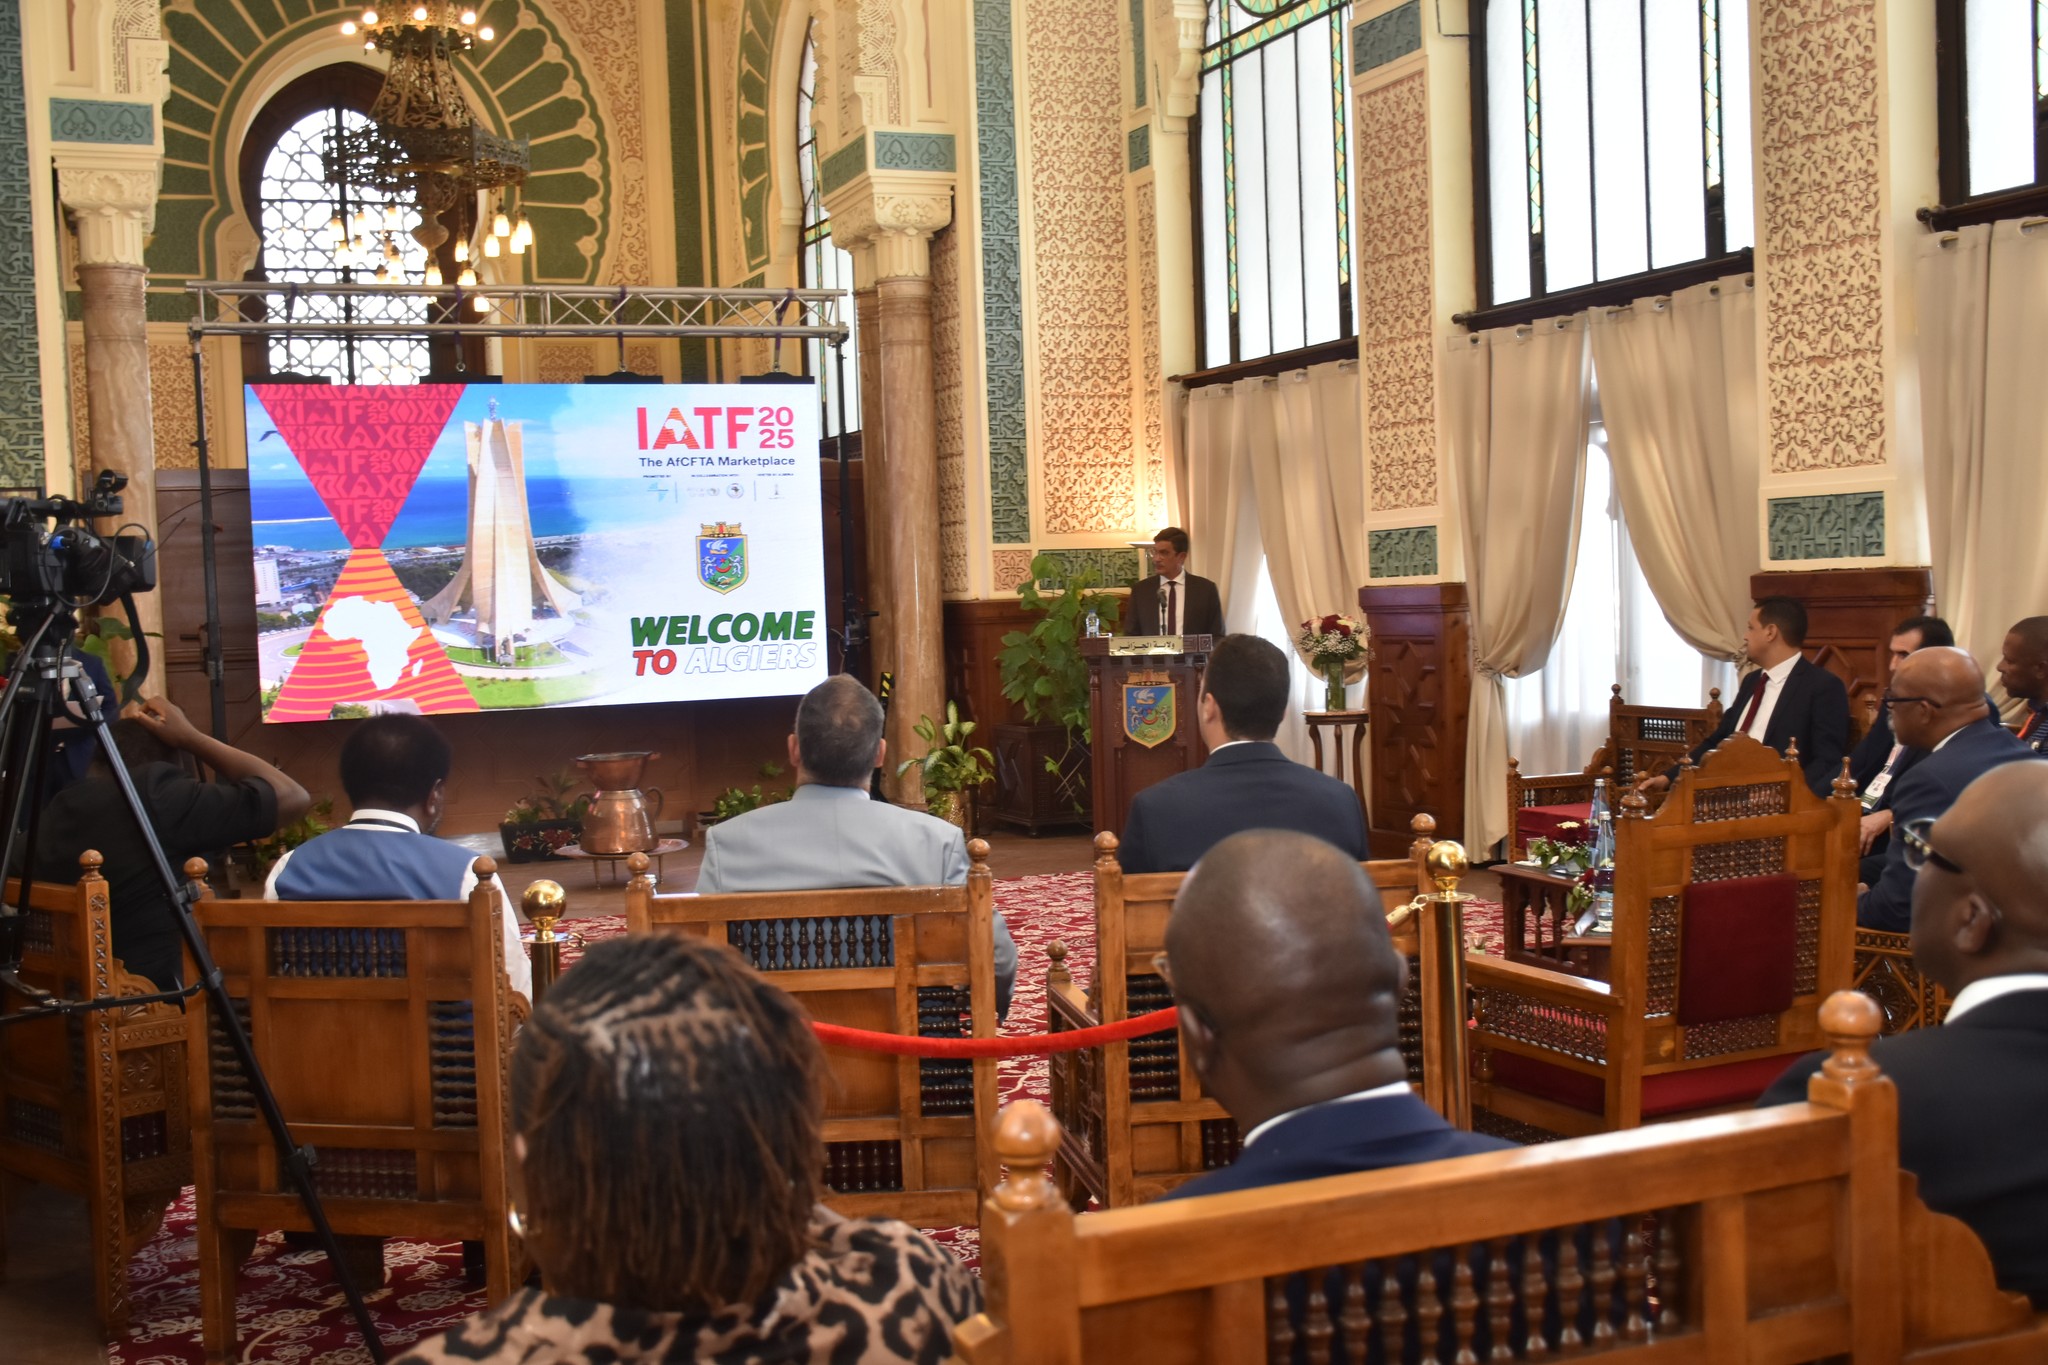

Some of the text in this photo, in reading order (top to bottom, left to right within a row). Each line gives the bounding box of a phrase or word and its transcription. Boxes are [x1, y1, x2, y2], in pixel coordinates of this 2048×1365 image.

[367, 400, 389, 411] 20
[367, 412, 389, 424] 25
[409, 425, 428, 436] 20
[637, 406, 794, 450] IATF 20
[409, 437, 430, 448] 25
[759, 429, 795, 449] 25
[370, 450, 392, 461] 20
[370, 462, 392, 473] 25
[639, 456, 795, 468] The AfCFTA Marketplace
[630, 610, 816, 647] WELCOME
[633, 642, 817, 676] TO ALGIERS
